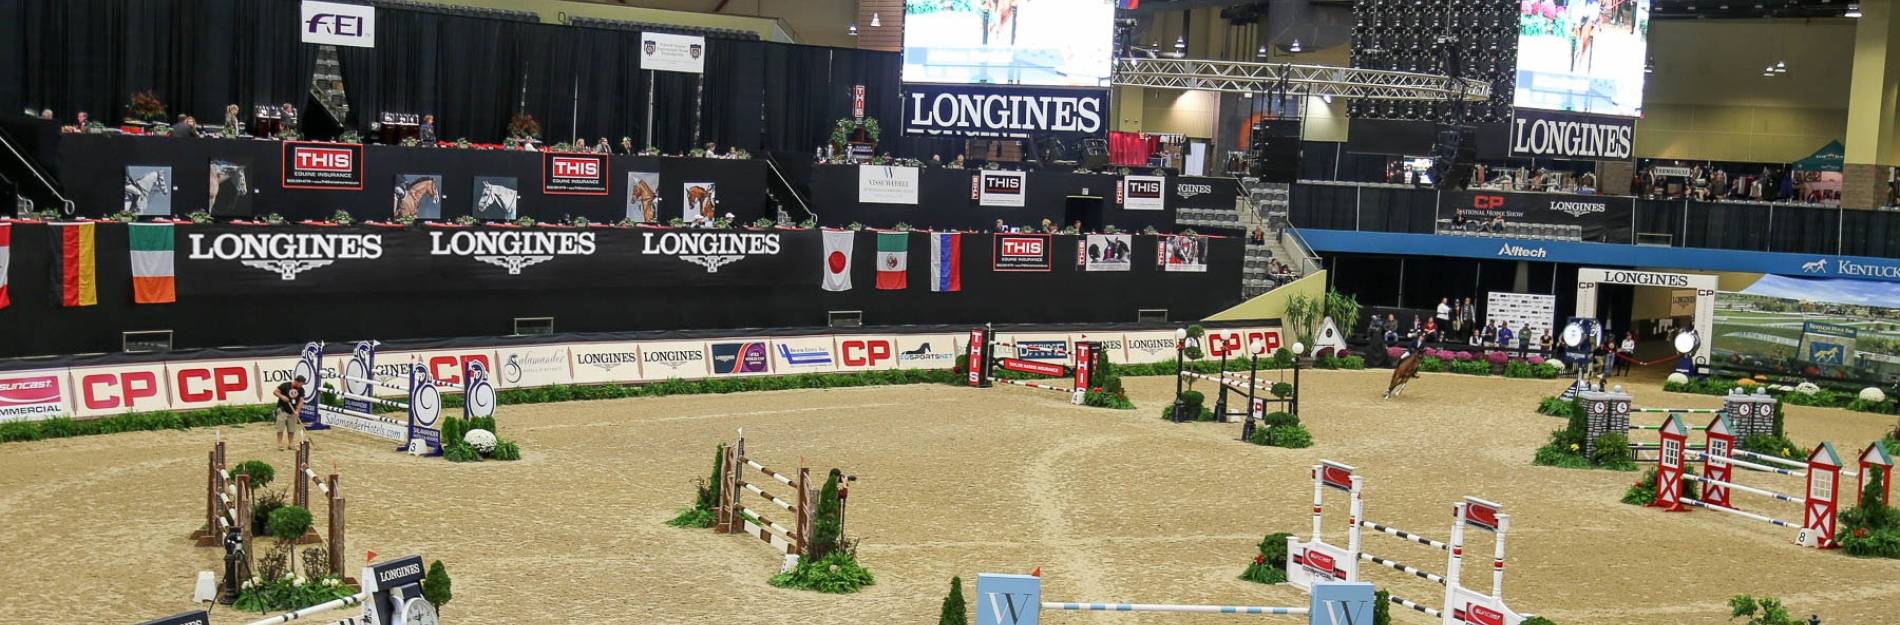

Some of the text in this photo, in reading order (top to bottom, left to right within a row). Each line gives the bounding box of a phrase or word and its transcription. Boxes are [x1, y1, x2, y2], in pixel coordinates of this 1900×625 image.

[305, 13, 363, 37] FEI
[911, 93, 1101, 133] LONGINES
[1514, 118, 1632, 159] LONGINES
[298, 152, 349, 167] THIS
[555, 161, 597, 175] THIS
[986, 177, 1020, 189] THIS
[1130, 182, 1159, 193] THIS
[1177, 183, 1212, 194] NGINES
[1474, 195, 1504, 208] CP
[1550, 201, 1606, 213] LONGINES
[188, 233, 382, 260] LONGINES
[430, 231, 596, 255] LONGINES
[642, 233, 781, 255] LONGINES
[1004, 242, 1041, 254] THIS
[1604, 271, 1688, 287] LONGINES
[1128, 339, 1174, 349] LONGINES
[1209, 333, 1240, 356] CP
[1249, 332, 1280, 354] CP
[577, 353, 635, 364] LONGINES
[644, 351, 702, 362] LONGINES
[842, 340, 890, 366] CP
[969, 331, 982, 382] THIS
[430, 355, 489, 386] CP
[82, 371, 157, 410] CP
[178, 367, 247, 403] CP
[410, 442, 416, 452] 3
[1799, 532, 1806, 543] 8
[380, 563, 420, 582] LONGINES
[984, 592, 1032, 625] W
